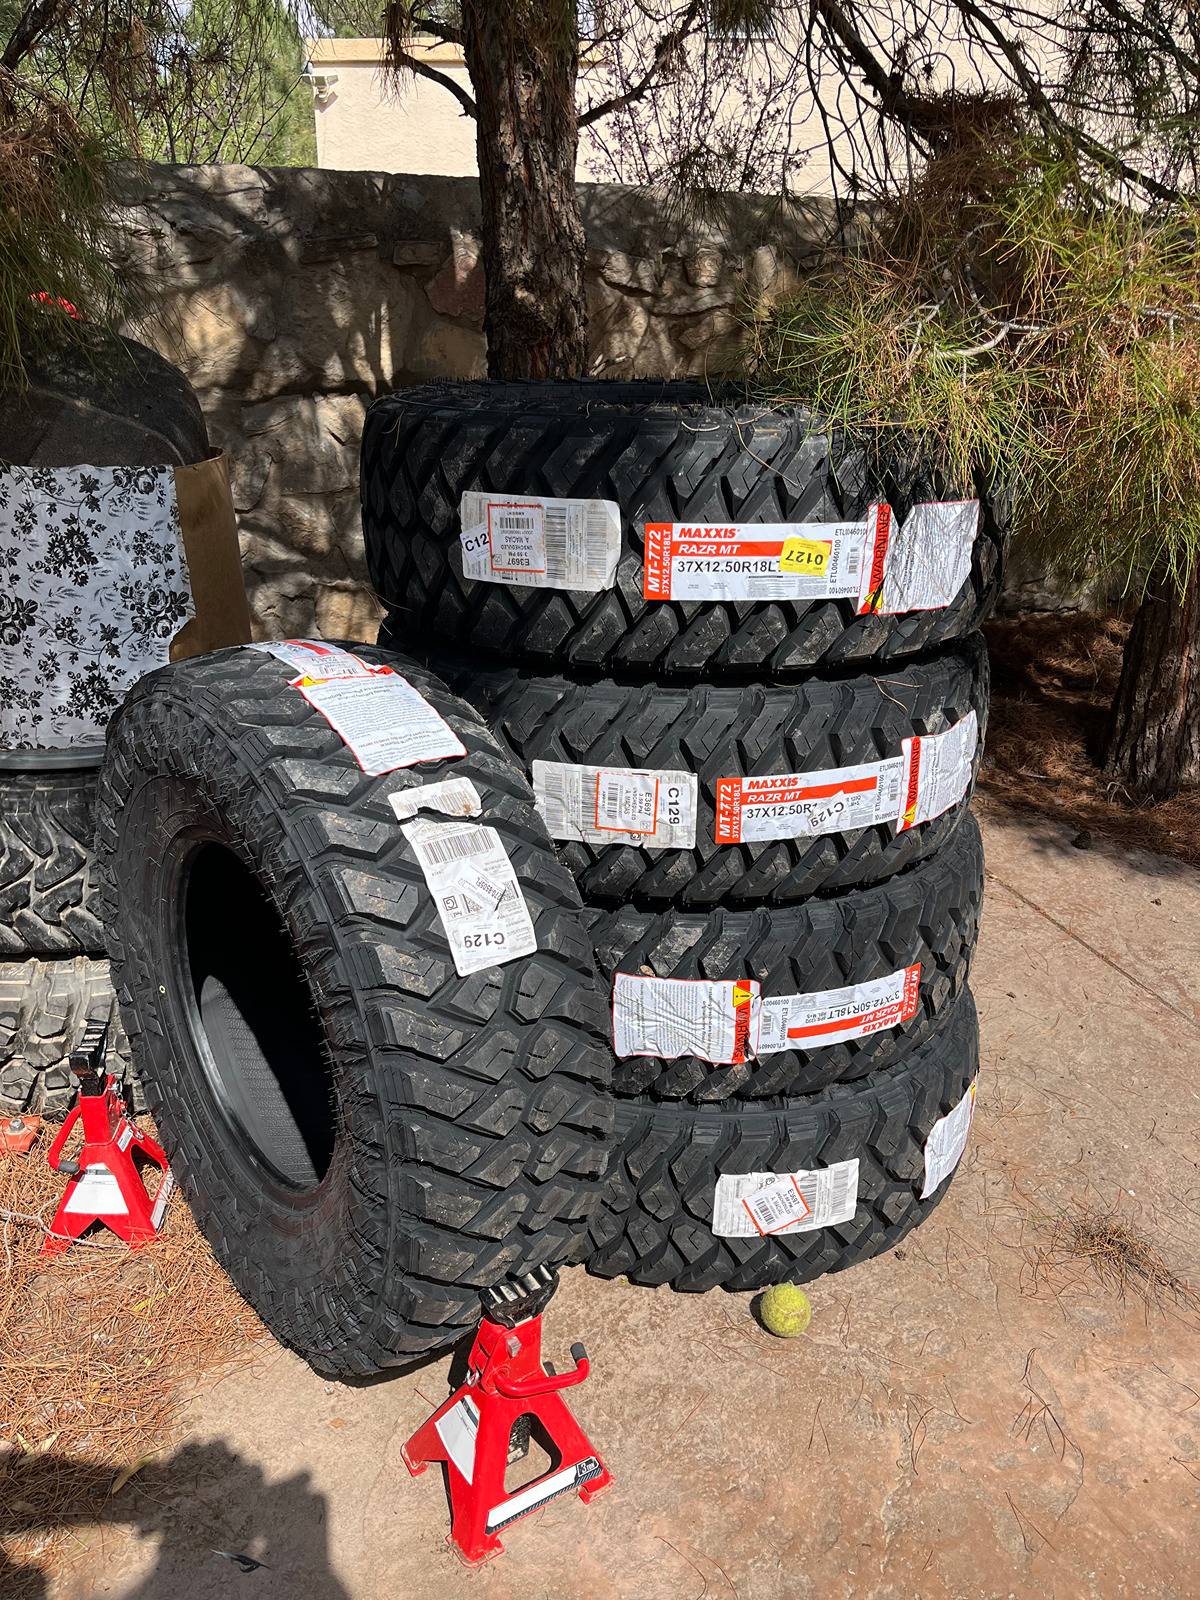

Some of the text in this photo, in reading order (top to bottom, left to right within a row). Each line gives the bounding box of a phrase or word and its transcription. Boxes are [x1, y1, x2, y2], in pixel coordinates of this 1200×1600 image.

[678, 528, 737, 538] MAXXIS
[834, 528, 867, 536] ETL0046010
[648, 530, 662, 592] MT-772
[662, 529, 672, 594] 37X12.50R18LT
[678, 544, 740, 554] RAZR MT
[785, 550, 824, 566] 0127
[830, 540, 842, 583] ETL00460100
[872, 510, 889, 588] WARNING
[507, 558, 530, 566] E3697
[748, 777, 799, 790] MAXXIS
[907, 739, 921, 804] WARNING
[644, 792, 652, 816] E3697
[668, 786, 680, 825] C129
[748, 790, 802, 802] RAZR MT
[720, 784, 734, 838] MT-772
[732, 784, 742, 839] 37X12.50R18LT
[810, 801, 845, 828] C129
[464, 932, 505, 948] C129
[906, 970, 919, 1014] MT-772
[860, 1004, 900, 1024] RAZR MT
[862, 1014, 898, 1034] MAXXIS
[734, 1007, 749, 1059] WARNING
